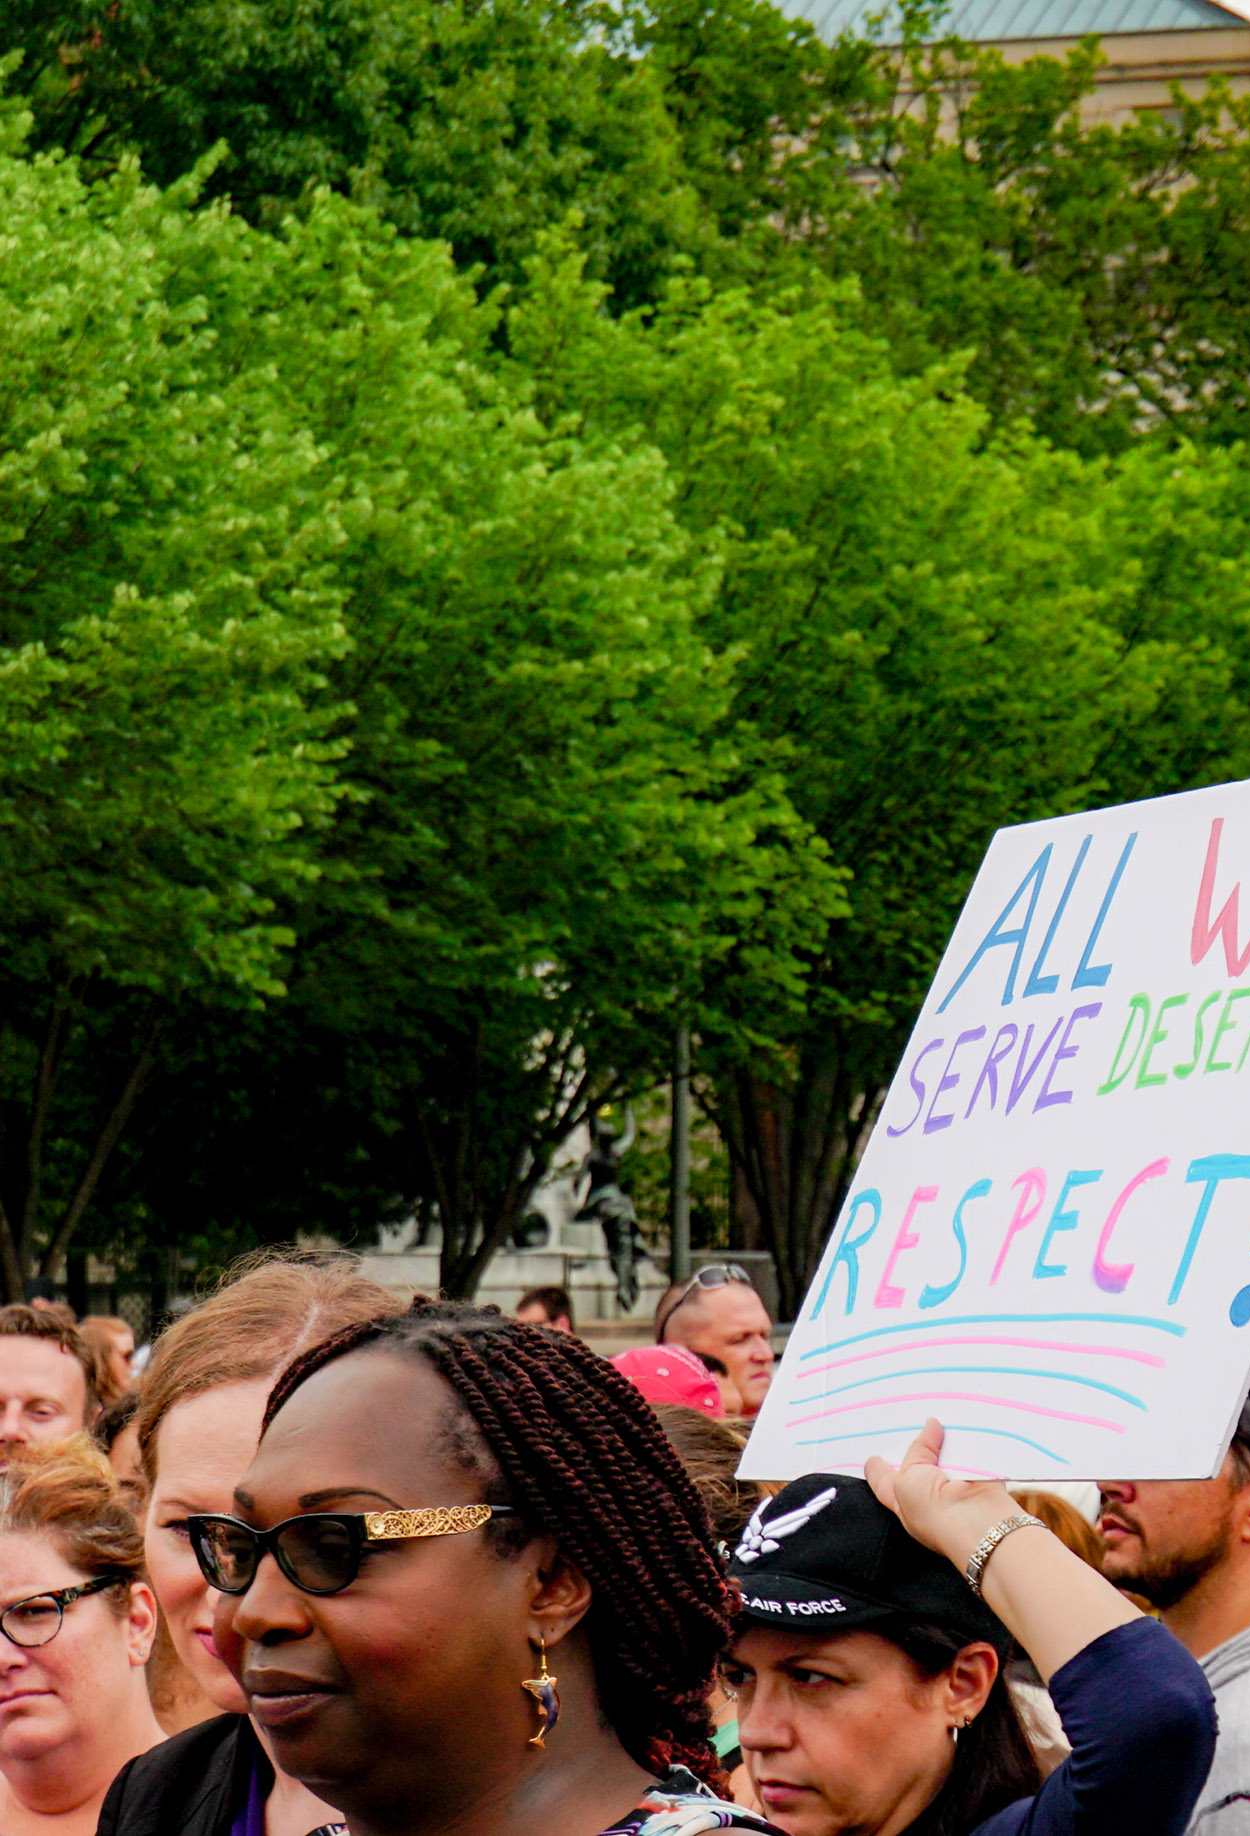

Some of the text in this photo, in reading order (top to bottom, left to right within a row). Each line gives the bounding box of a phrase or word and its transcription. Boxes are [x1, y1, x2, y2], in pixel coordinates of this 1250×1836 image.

[935, 831, 1139, 1015] ALL
[886, 1002, 1103, 1138] SERVE
[750, 1597, 783, 1614] AIR
[785, 1598, 847, 1616] FORCE
